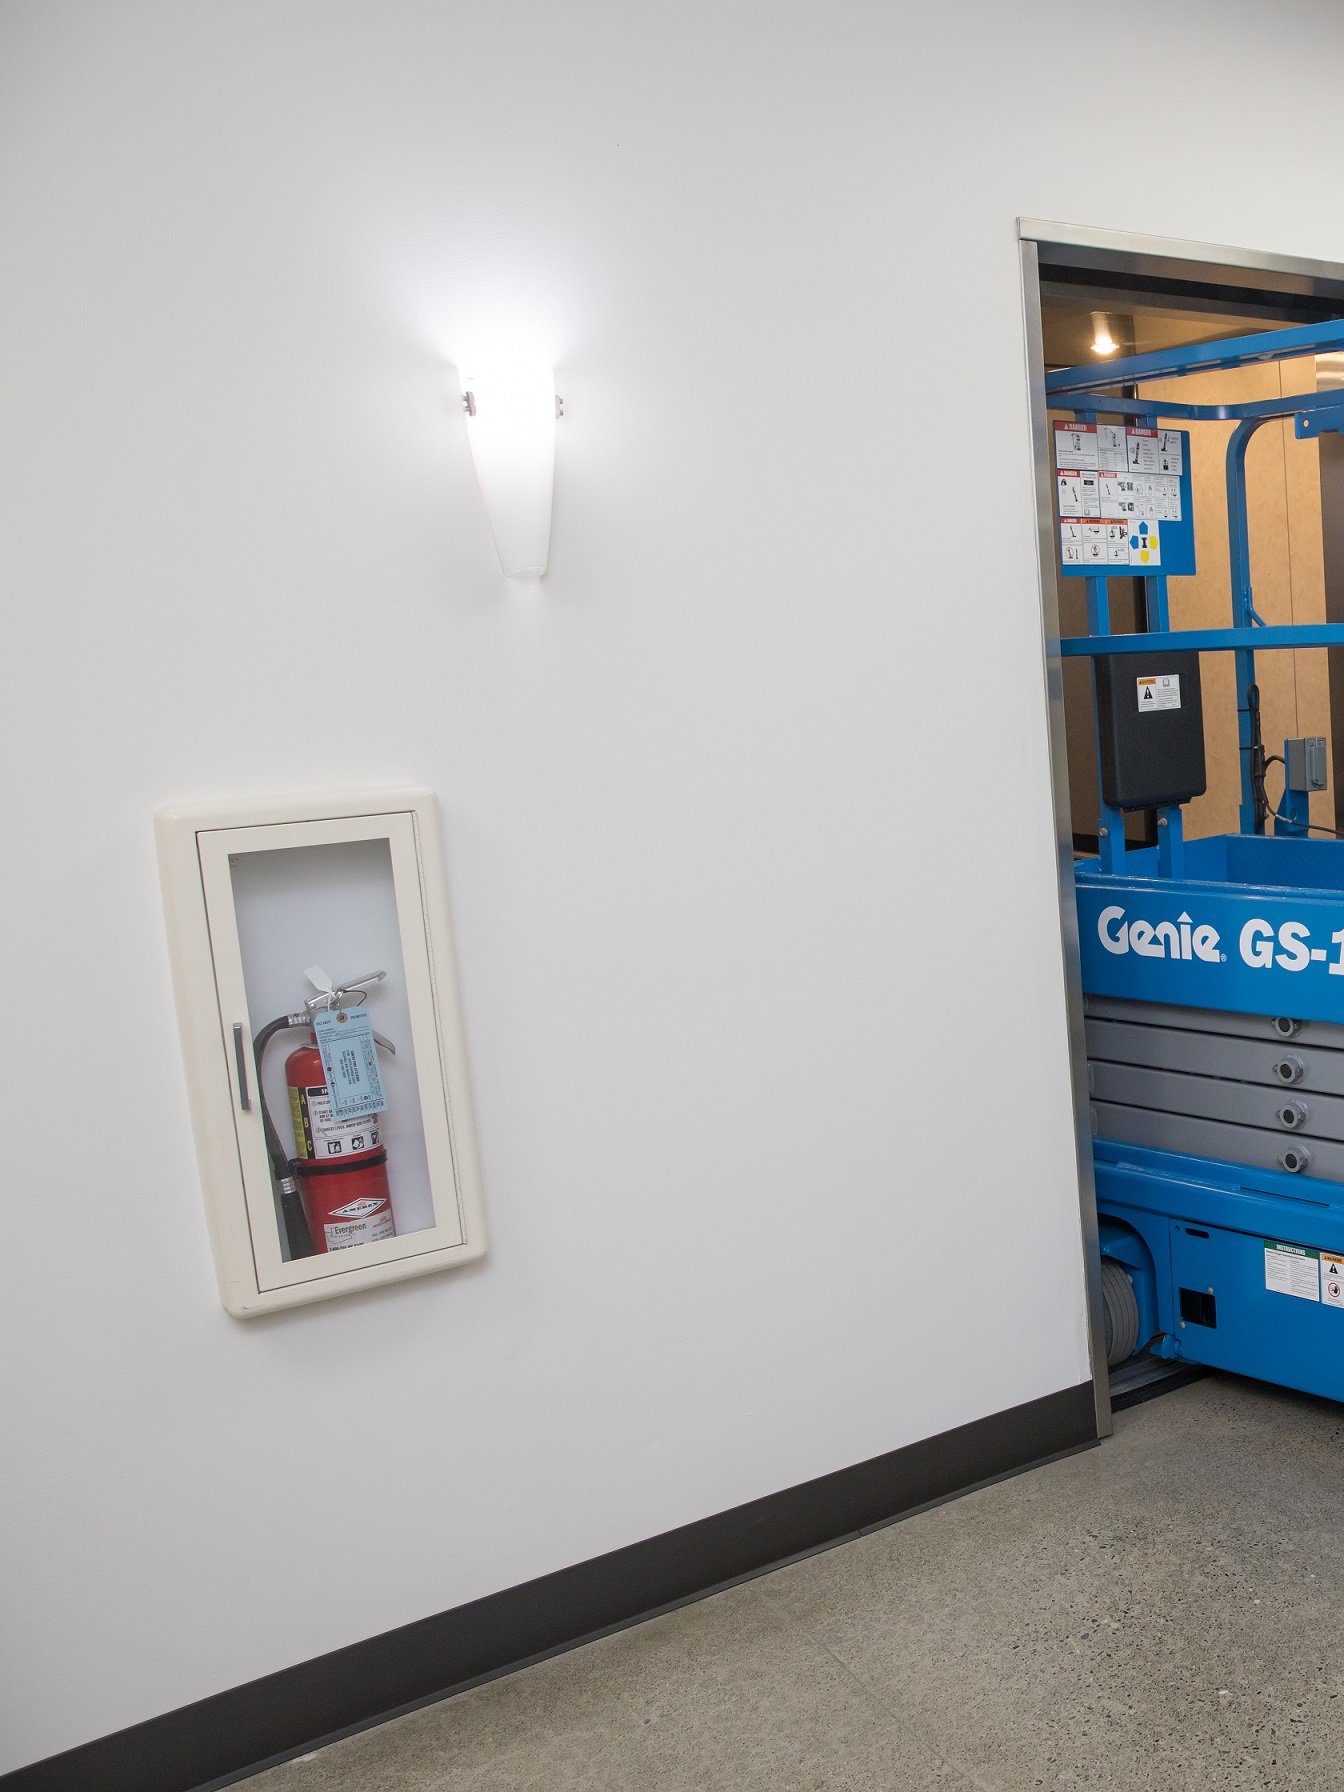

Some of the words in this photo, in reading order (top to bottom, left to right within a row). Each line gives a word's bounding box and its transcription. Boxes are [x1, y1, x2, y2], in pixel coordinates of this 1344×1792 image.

[1069, 423, 1088, 432] DANGER
[1135, 428, 1152, 436] DANGER
[1097, 905, 1222, 963] Genie
[300, 1094, 306, 1105] A
[303, 1117, 309, 1128] B
[307, 1140, 313, 1151] C
[342, 1201, 379, 1213] AMEREX
[334, 1222, 367, 1236] Evergreen
[1276, 1244, 1306, 1256] INSTRUCTIONS
